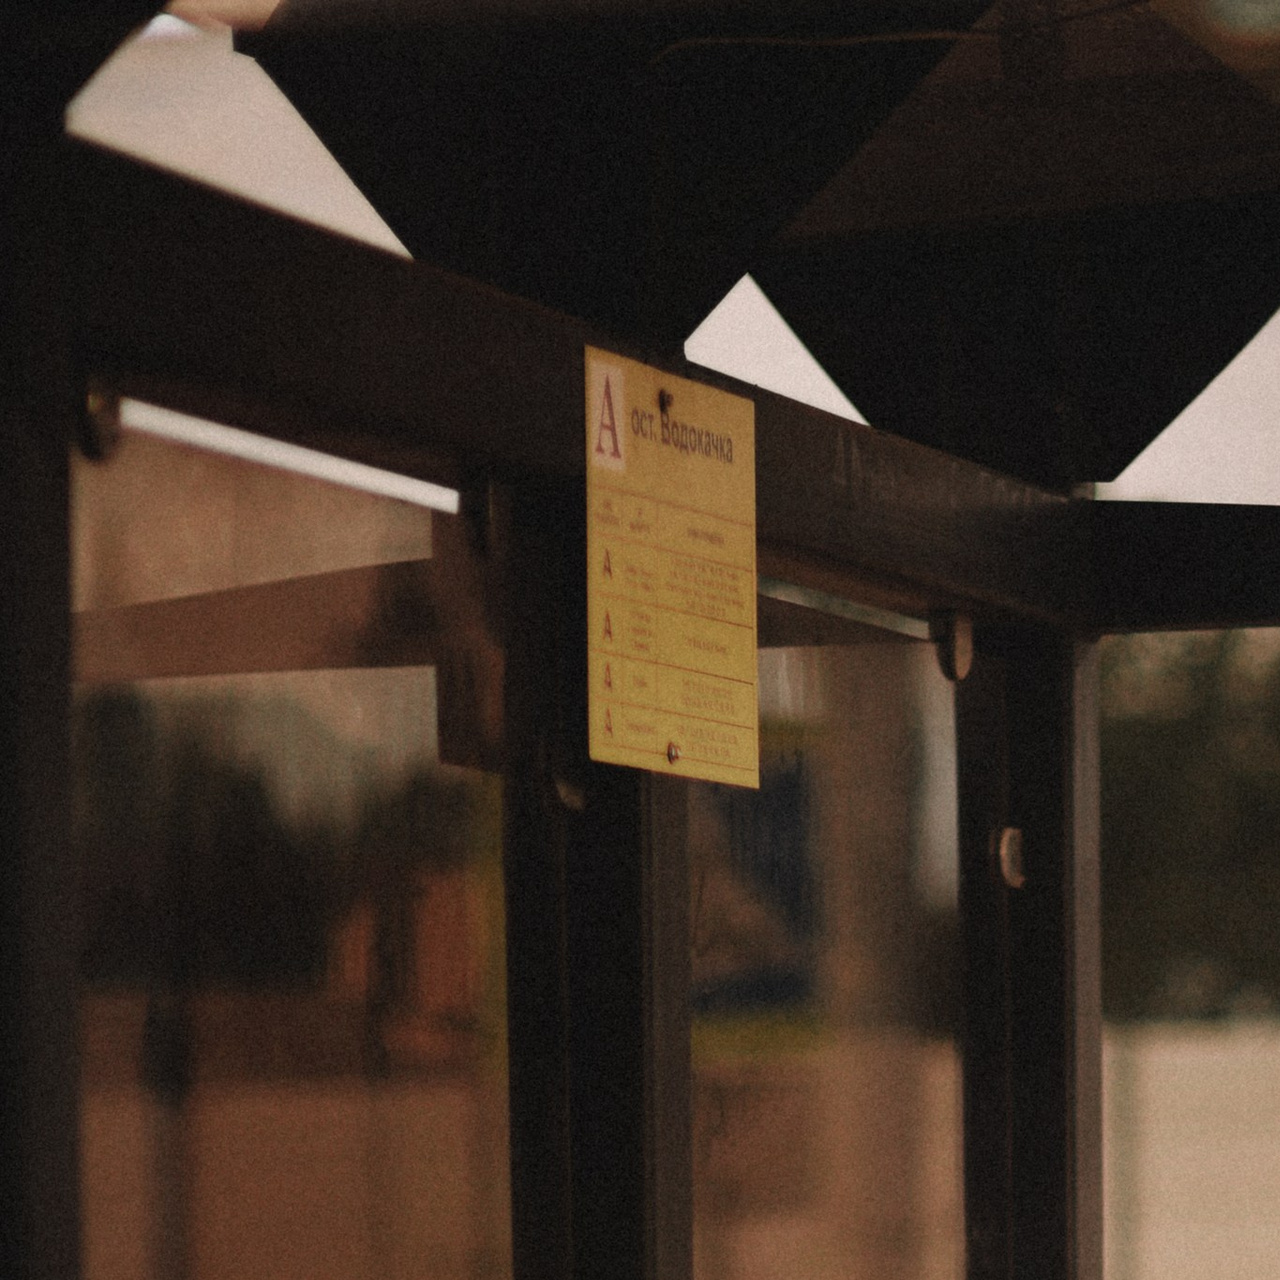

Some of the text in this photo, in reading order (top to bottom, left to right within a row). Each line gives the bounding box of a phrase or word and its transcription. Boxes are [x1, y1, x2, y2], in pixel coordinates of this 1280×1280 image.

[595, 373, 622, 460] А
[631, 406, 733, 464] ост. Водокачка
